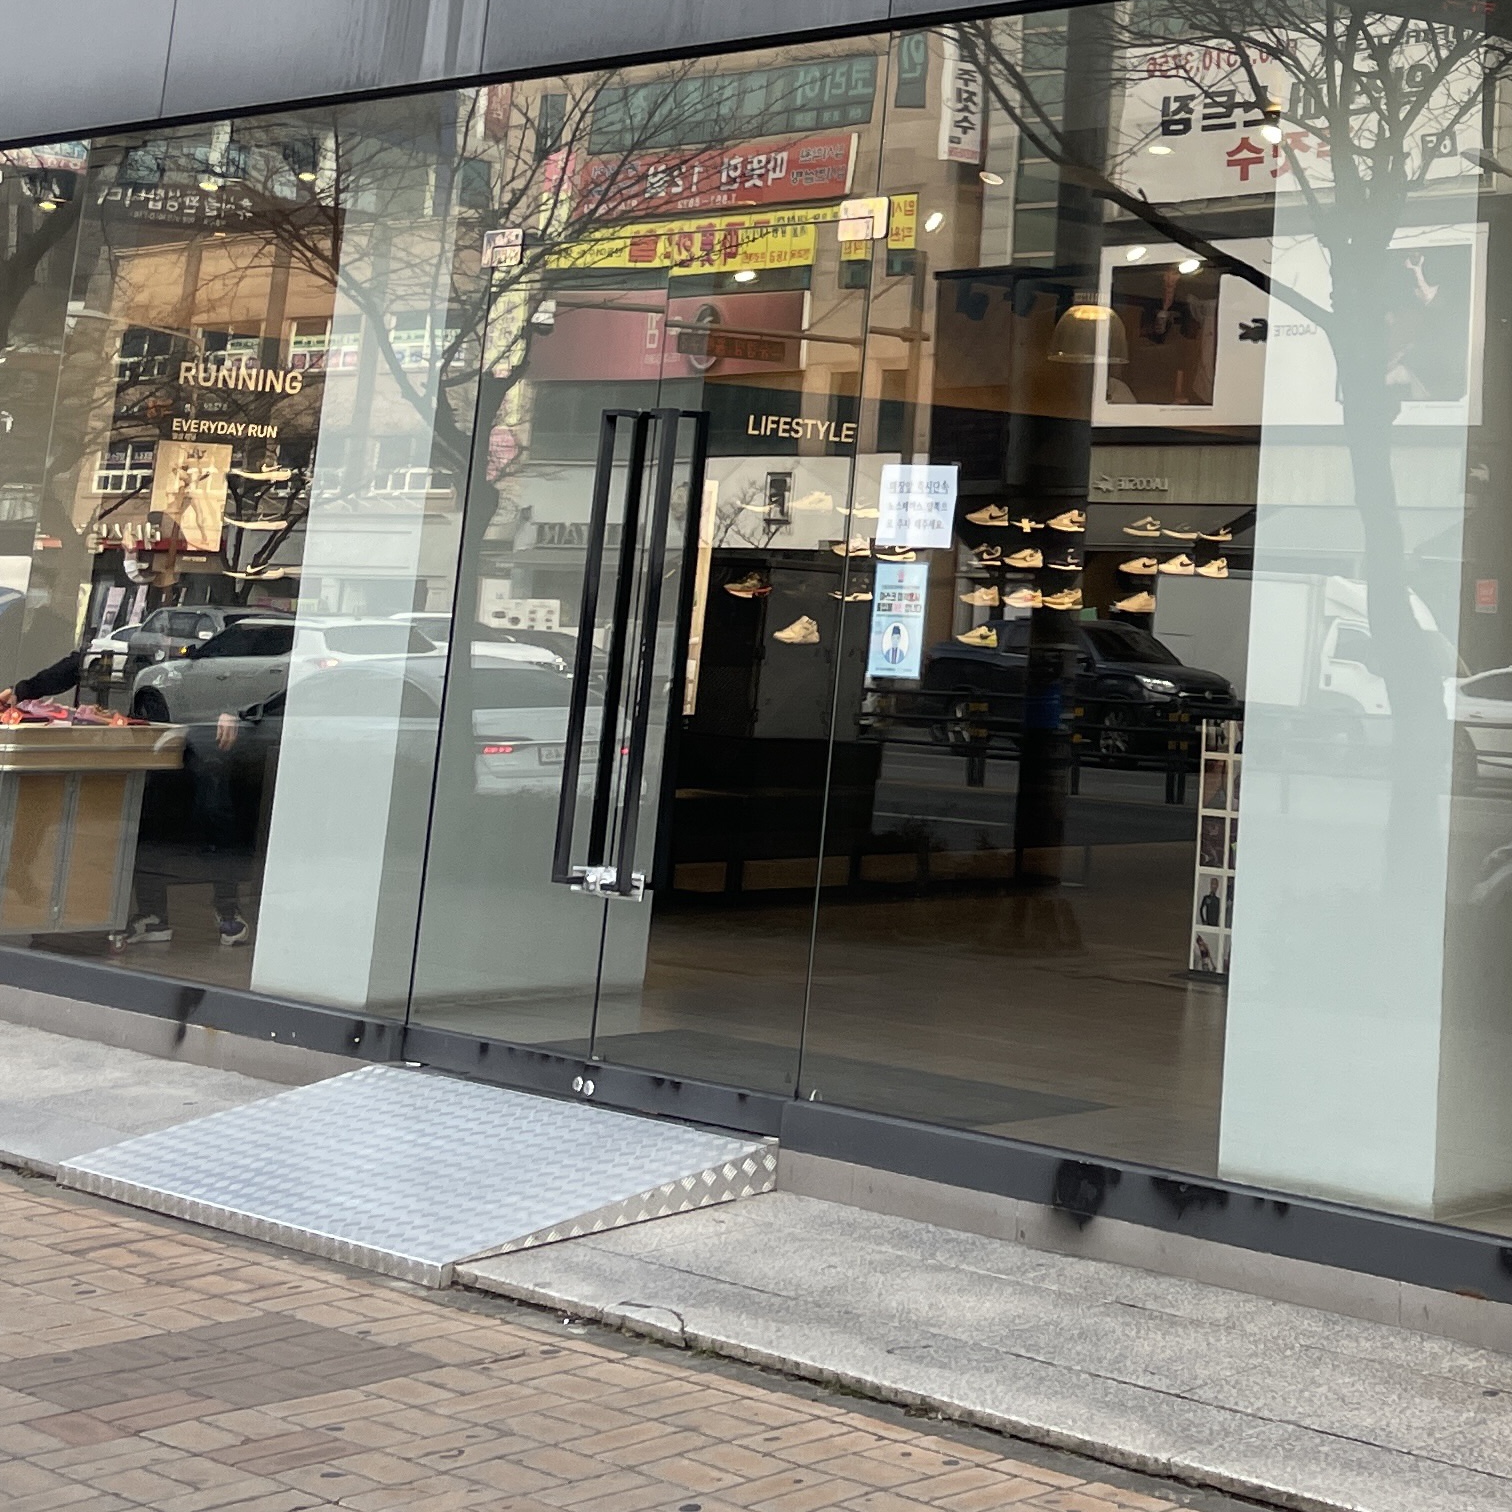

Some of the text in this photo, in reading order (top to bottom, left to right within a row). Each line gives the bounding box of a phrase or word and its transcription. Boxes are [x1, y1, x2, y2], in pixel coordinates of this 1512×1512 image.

[178, 360, 303, 396] RUNNING
[171, 417, 278, 439] EVERYDAY RUN
[747, 413, 858, 443] LIFESTYLE
